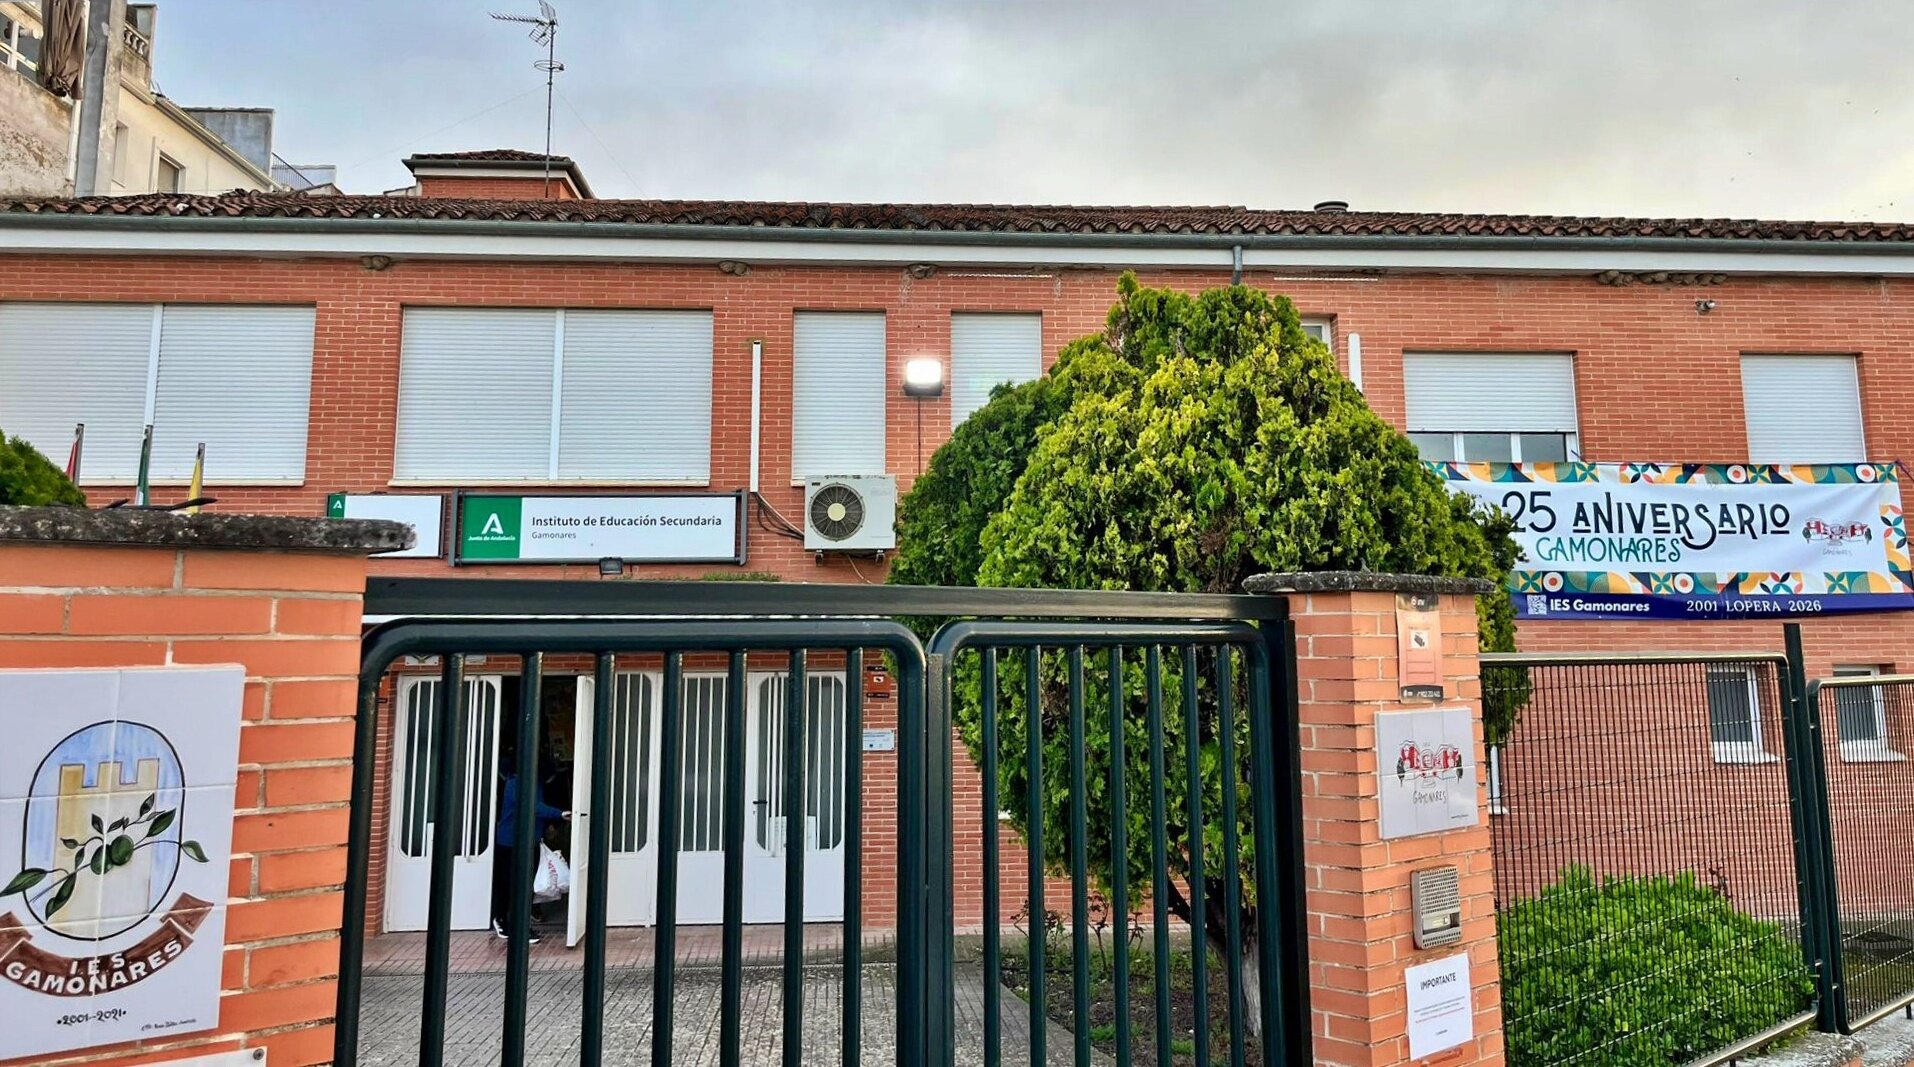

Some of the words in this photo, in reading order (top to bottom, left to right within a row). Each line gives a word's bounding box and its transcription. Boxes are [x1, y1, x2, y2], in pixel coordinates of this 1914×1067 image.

[532, 516, 580, 526] Instituto
[583, 516, 597, 526] de
[600, 515, 657, 526] Educación
[660, 516, 722, 526] Secundaria
[1501, 490, 1557, 533] 25
[1572, 491, 1790, 550] ANIVERSARIO
[532, 531, 577, 539] Gamonares
[1536, 536, 1681, 563] GAMONARES
[1550, 599, 1571, 611] IES
[1574, 600, 1650, 612] Gamonares
[1687, 600, 1718, 612] 2001
[1726, 600, 1782, 612] LOPERA
[1788, 600, 1822, 612] 2026
[5, 940, 183, 994] GAMONARES
[1420, 972, 1457, 990] IMPORTANTE
